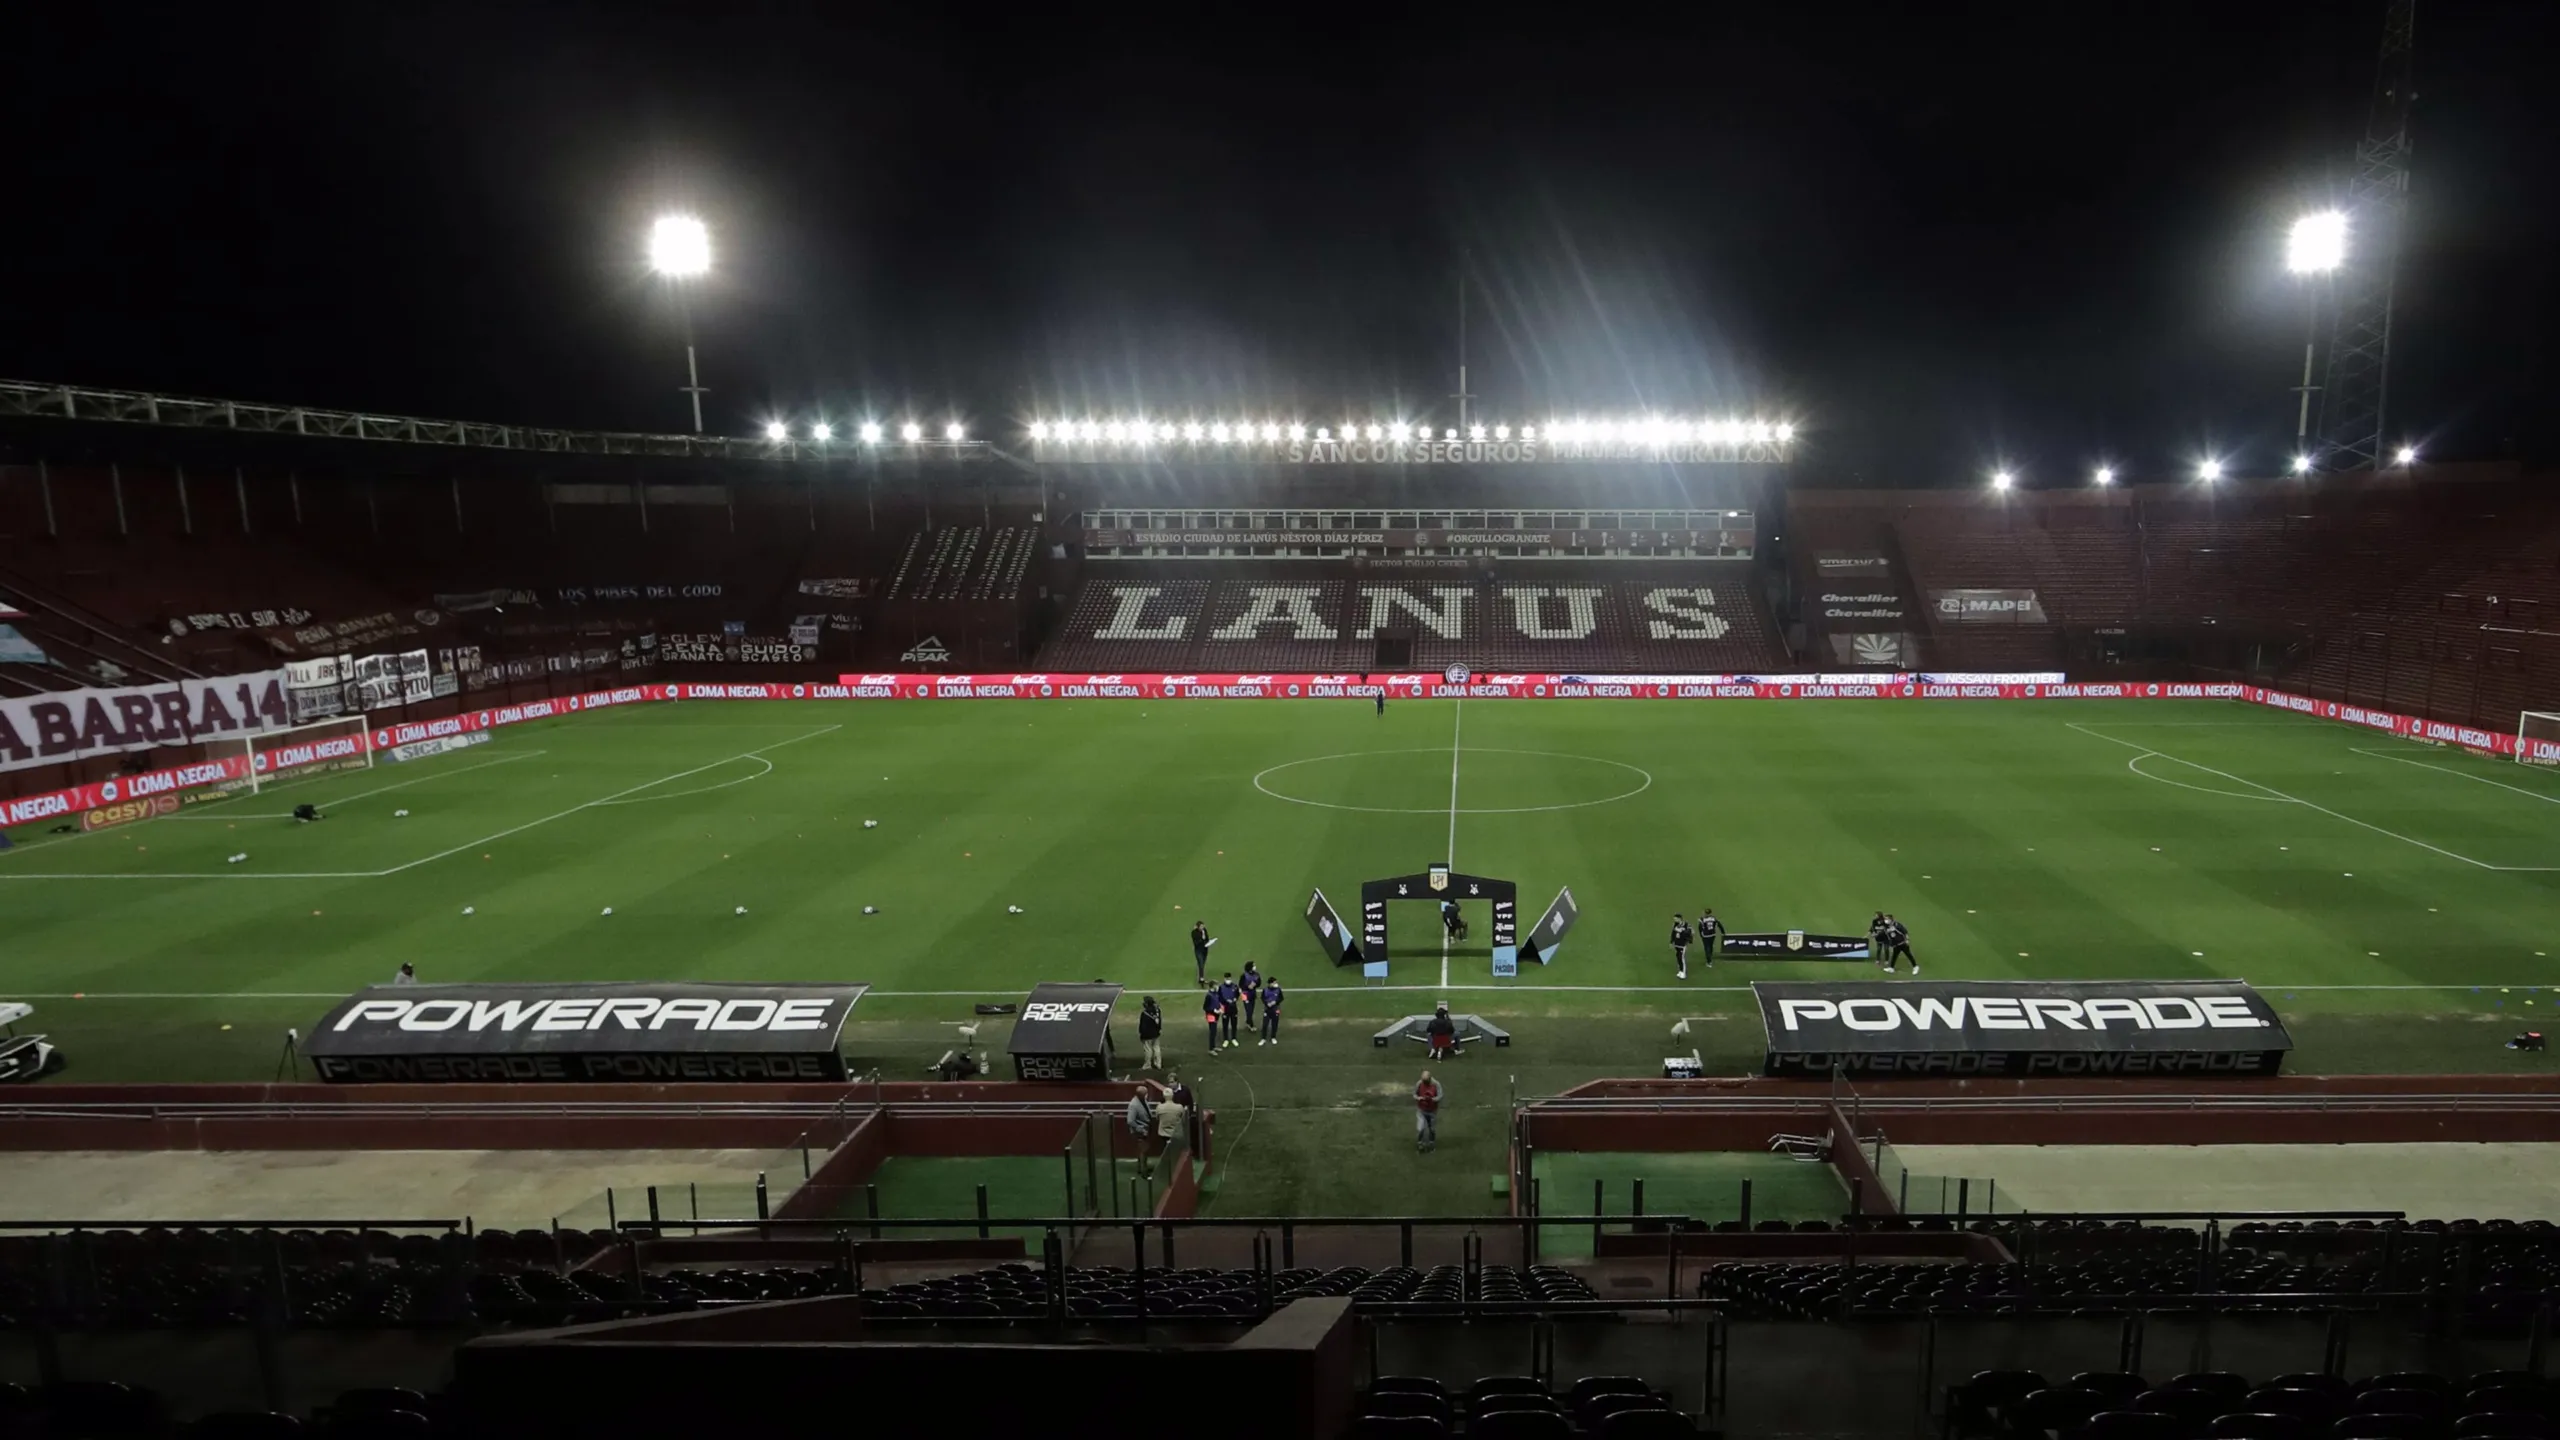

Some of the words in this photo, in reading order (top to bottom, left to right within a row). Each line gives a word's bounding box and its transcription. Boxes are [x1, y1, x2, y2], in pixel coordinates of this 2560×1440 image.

[1289, 443, 1408, 463] SANCOR
[1415, 443, 1537, 463] SEGUROS
[1136, 533, 1181, 543] ESTADIO
[1183, 533, 1225, 543] CIUDAD
[1226, 533, 1241, 543] DE
[1243, 531, 1278, 543] LANÚS
[1351, 531, 1384, 543] PÉREZ
[1447, 534, 1550, 543] #ORGULLOGRANATE
[646, 586, 675, 599] DEL
[682, 585, 722, 598] CODO
[1969, 599, 2031, 611] MAPEI
[1092, 586, 1731, 640] LANUS
[901, 653, 951, 662] PEAK
[688, 685, 724, 698] LOMA
[727, 685, 768, 698] NEGRA
[813, 685, 849, 698] LOMA
[852, 685, 892, 698] NEGRA
[937, 685, 973, 698] LOMA
[976, 685, 1015, 698] NEGRA
[1061, 685, 1097, 698] LOMA
[1100, 685, 1138, 698] NEGRA
[1185, 685, 1221, 698] LOMA
[1224, 685, 1263, 698] NEGRA
[1309, 685, 1345, 697] LOMA
[1347, 685, 1386, 697] NEGRA
[1431, 685, 1467, 697] LOMA
[1470, 685, 1509, 697] NEGRA
[1554, 685, 1591, 697] LOMA
[1593, 685, 1632, 697] NEGRA
[1677, 685, 1713, 697] LOMA
[1715, 685, 1755, 697] NEGRA
[1800, 685, 1836, 697] LOMA
[1839, 685, 1878, 697] NEGRA
[1923, 685, 1959, 697] LOMA
[1961, 685, 1999, 697] NEGRA
[2045, 684, 2081, 697] LOMA
[2084, 684, 2122, 697] NEGRA
[2167, 684, 2202, 697] LOMA
[2205, 684, 2244, 697] NEGRA
[584, 692, 611, 709] LOMA
[612, 688, 641, 705] NEGRA
[2266, 693, 2288, 707] LOMA
[2289, 697, 2313, 712] NEGRA
[495, 708, 521, 724] LOMA
[523, 702, 553, 721] NEGRA
[2341, 706, 2365, 723] LOMA
[2366, 711, 2394, 729] NEGRA
[396, 726, 427, 744] LOMA
[428, 719, 462, 739] NEGRA
[2427, 723, 2456, 741] LOMA
[2458, 729, 2492, 748] NEGRA
[276, 745, 315, 768] LOMA
[316, 739, 356, 760] NEGRA
[402, 741, 442, 760] sica
[128, 772, 176, 797] LOMA
[177, 762, 226, 786] NEGRA
[10, 794, 69, 822] NEGRA
[89, 800, 150, 824] easy
[1026, 1002, 1109, 1012] POWER
[333, 997, 832, 1032] POWERADE
[1022, 1012, 1070, 1021] ADE
[1777, 996, 2262, 1032] POWERADE
[322, 1055, 571, 1078] POWERADE
[586, 1054, 821, 1078] POWERADE
[1020, 1057, 1097, 1068] POWER
[1772, 1052, 2008, 1074] POWERADE
[2027, 1051, 2264, 1075] POWERADE
[1023, 1068, 1066, 1079] ADE
